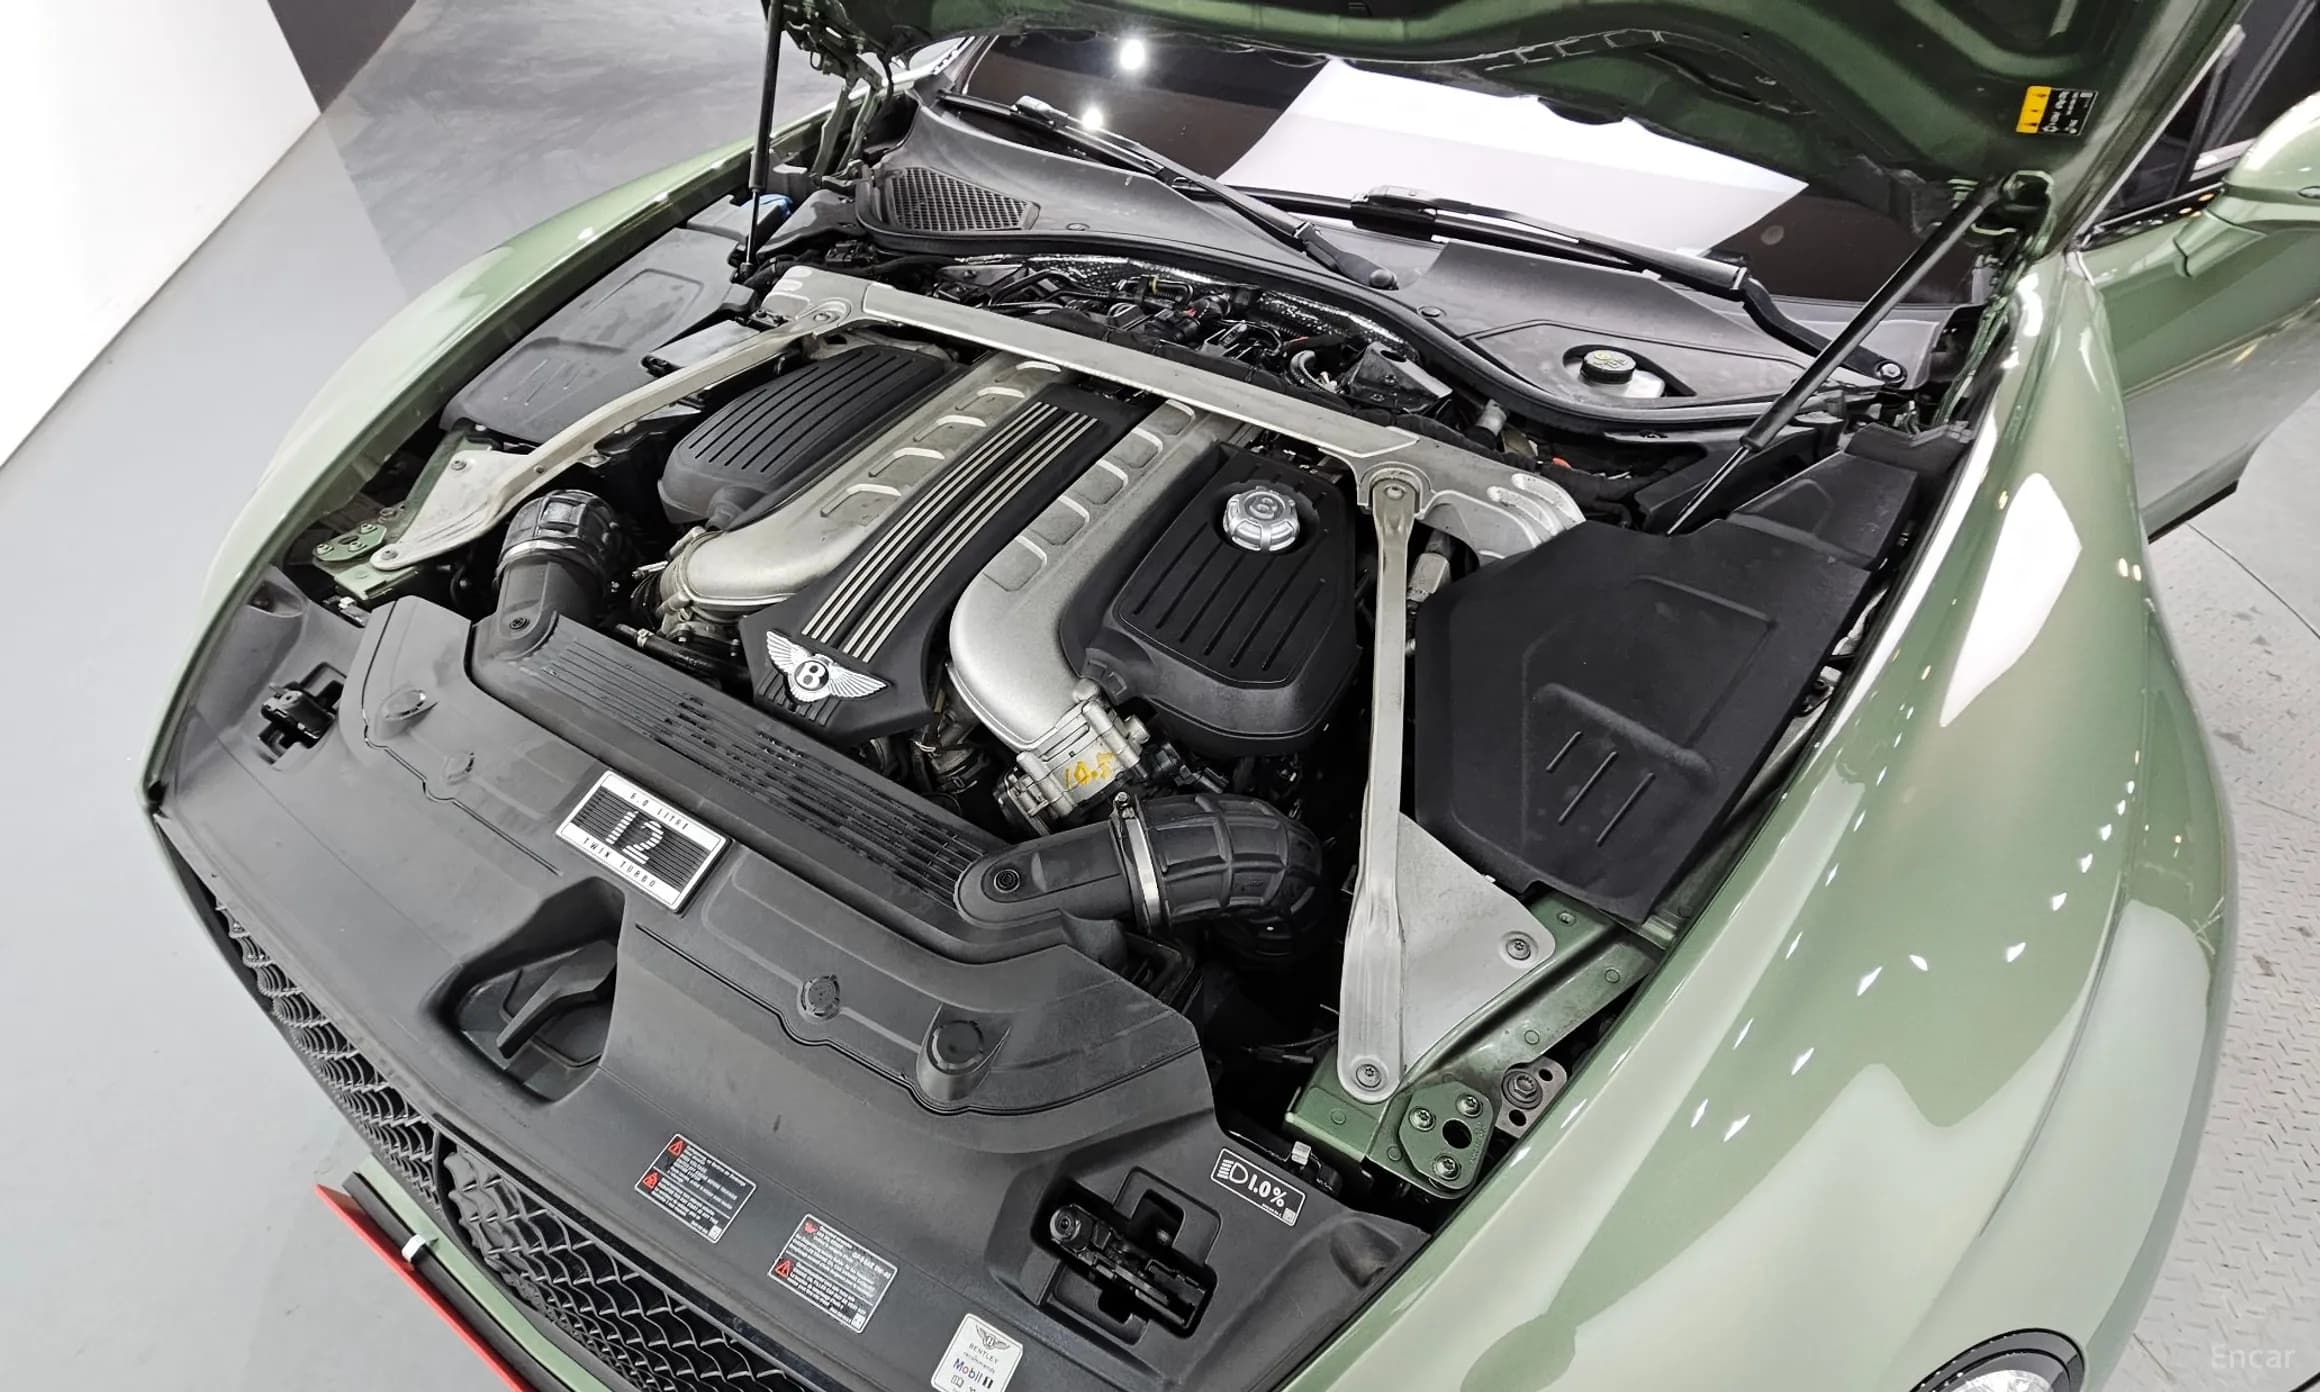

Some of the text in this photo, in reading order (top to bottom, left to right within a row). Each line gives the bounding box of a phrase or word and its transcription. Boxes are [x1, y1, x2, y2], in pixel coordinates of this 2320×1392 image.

[605, 810, 665, 865] 12
[620, 861, 656, 888] TURBO
[1247, 1173, 1288, 1208] 1.0%
[968, 1343, 999, 1364] BENTLEY
[953, 1357, 983, 1383] Mobil
